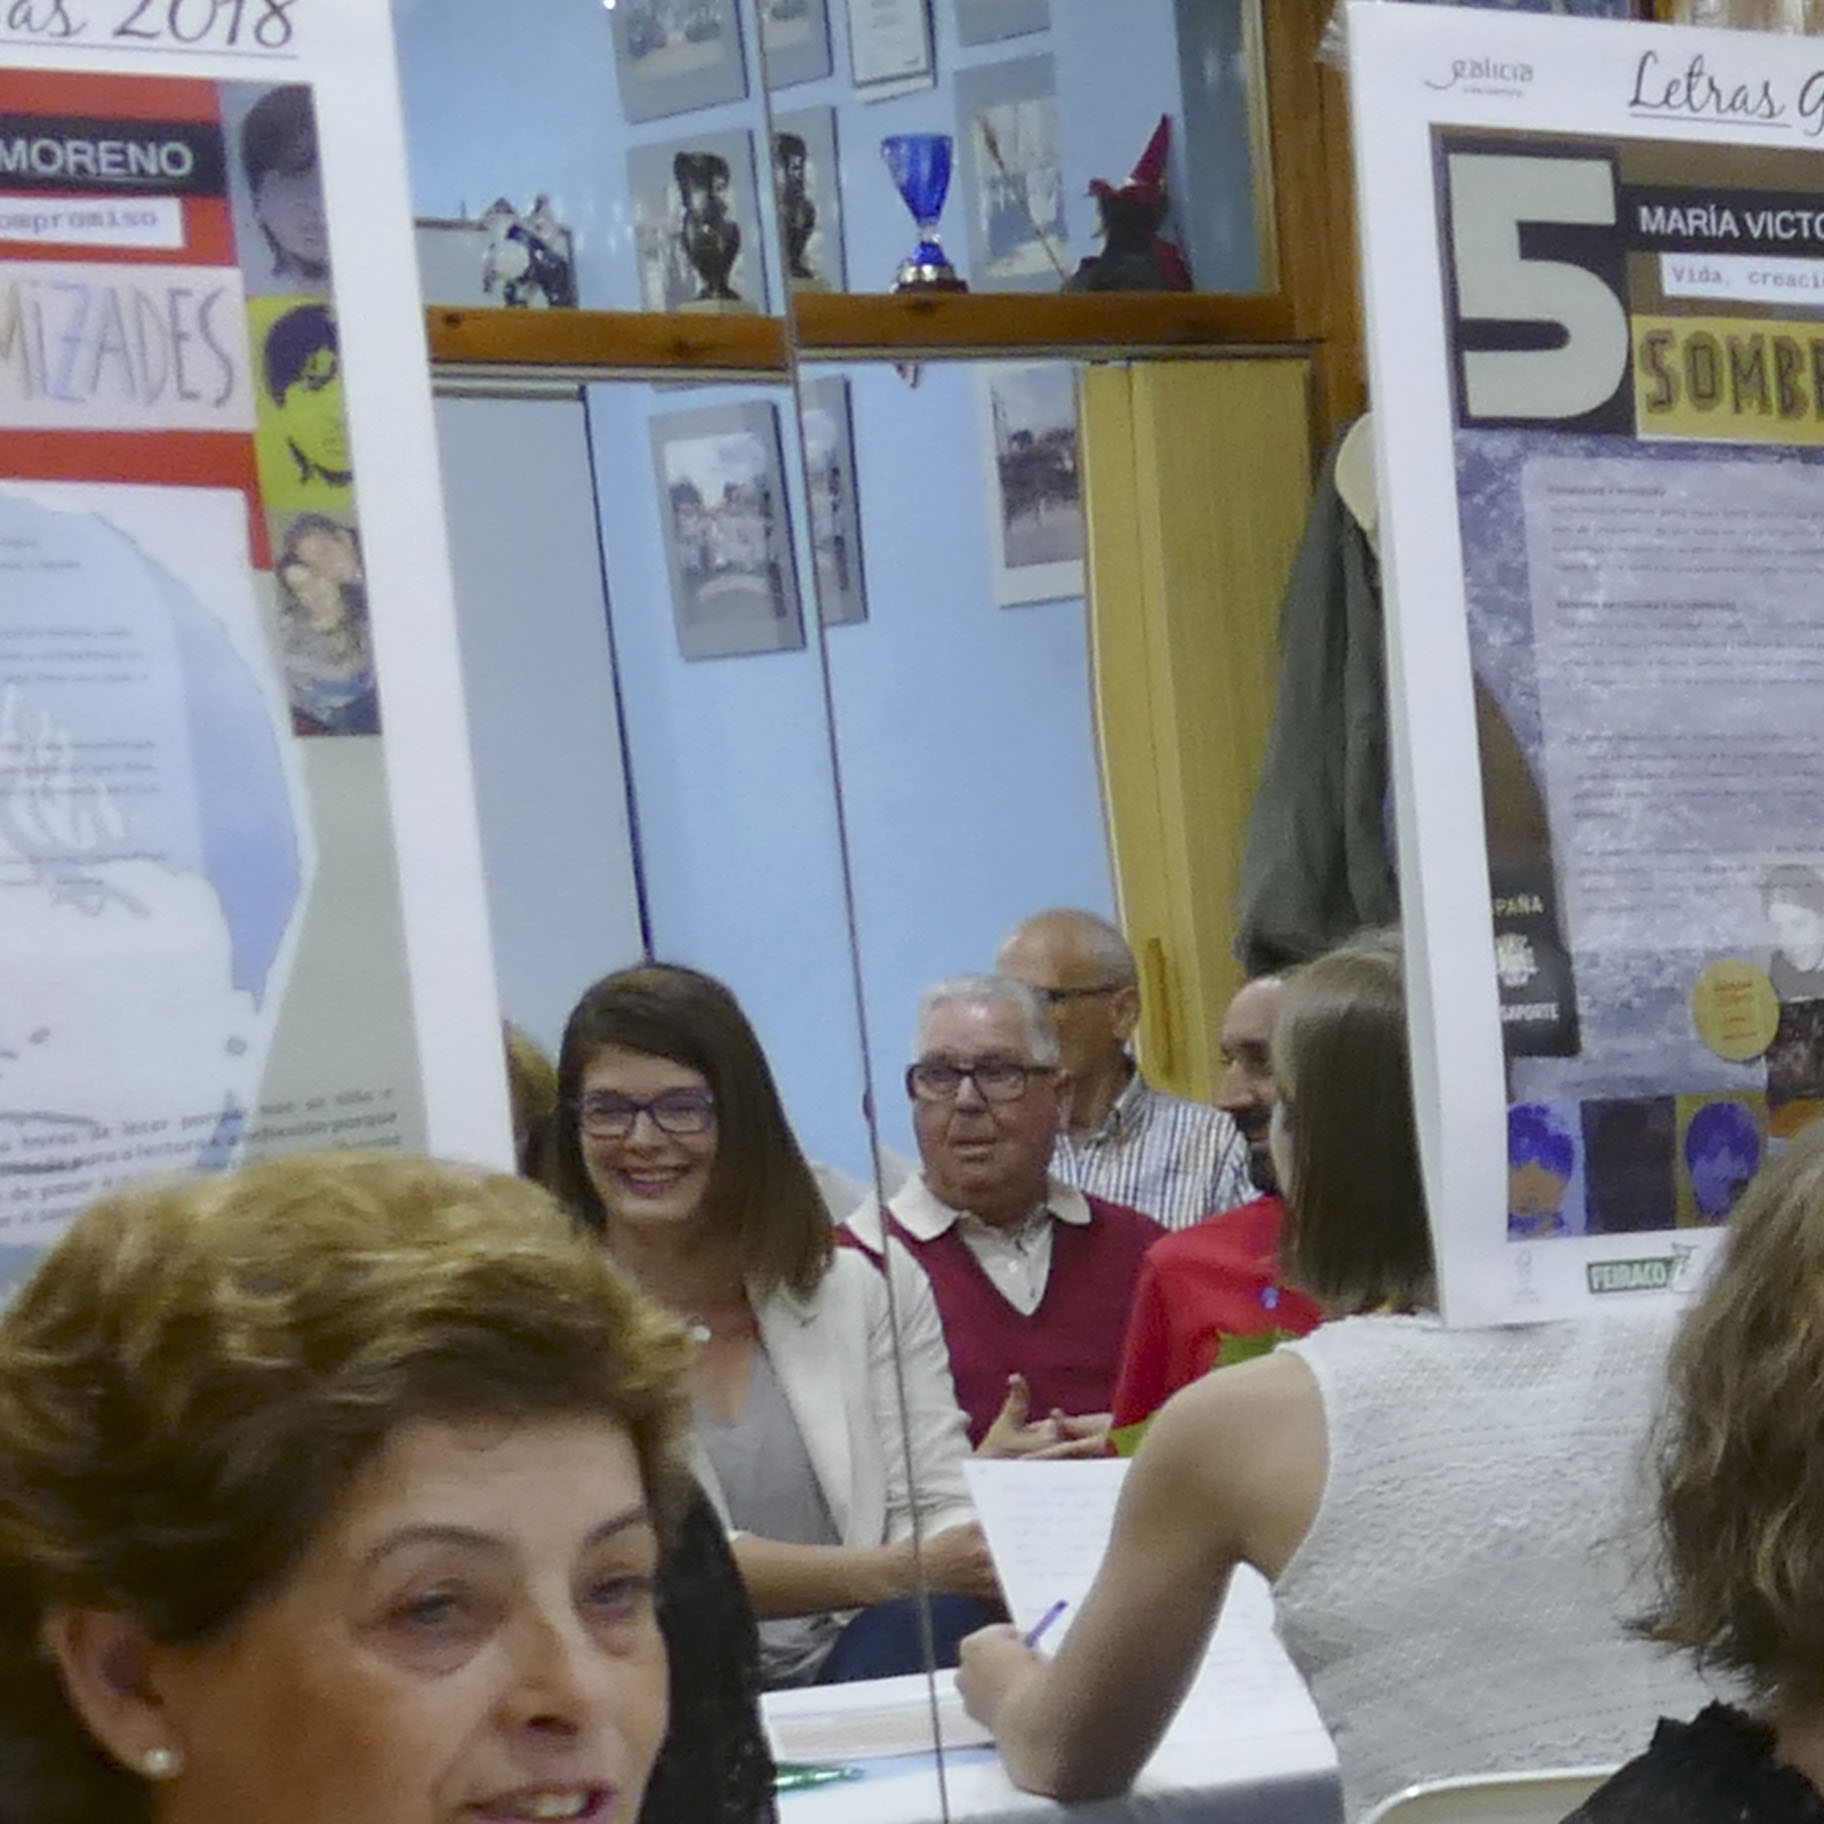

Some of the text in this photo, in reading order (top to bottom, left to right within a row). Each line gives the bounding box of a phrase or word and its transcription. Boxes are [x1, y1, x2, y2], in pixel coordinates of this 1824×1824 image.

[112, 0, 293, 48] 2018
[1424, 57, 1534, 90] galicia
[1628, 50, 1786, 119] Letras
[0, 137, 194, 178] MORENO
[1639, 204, 1740, 239] MARÍA
[1447, 152, 1629, 421] 5
